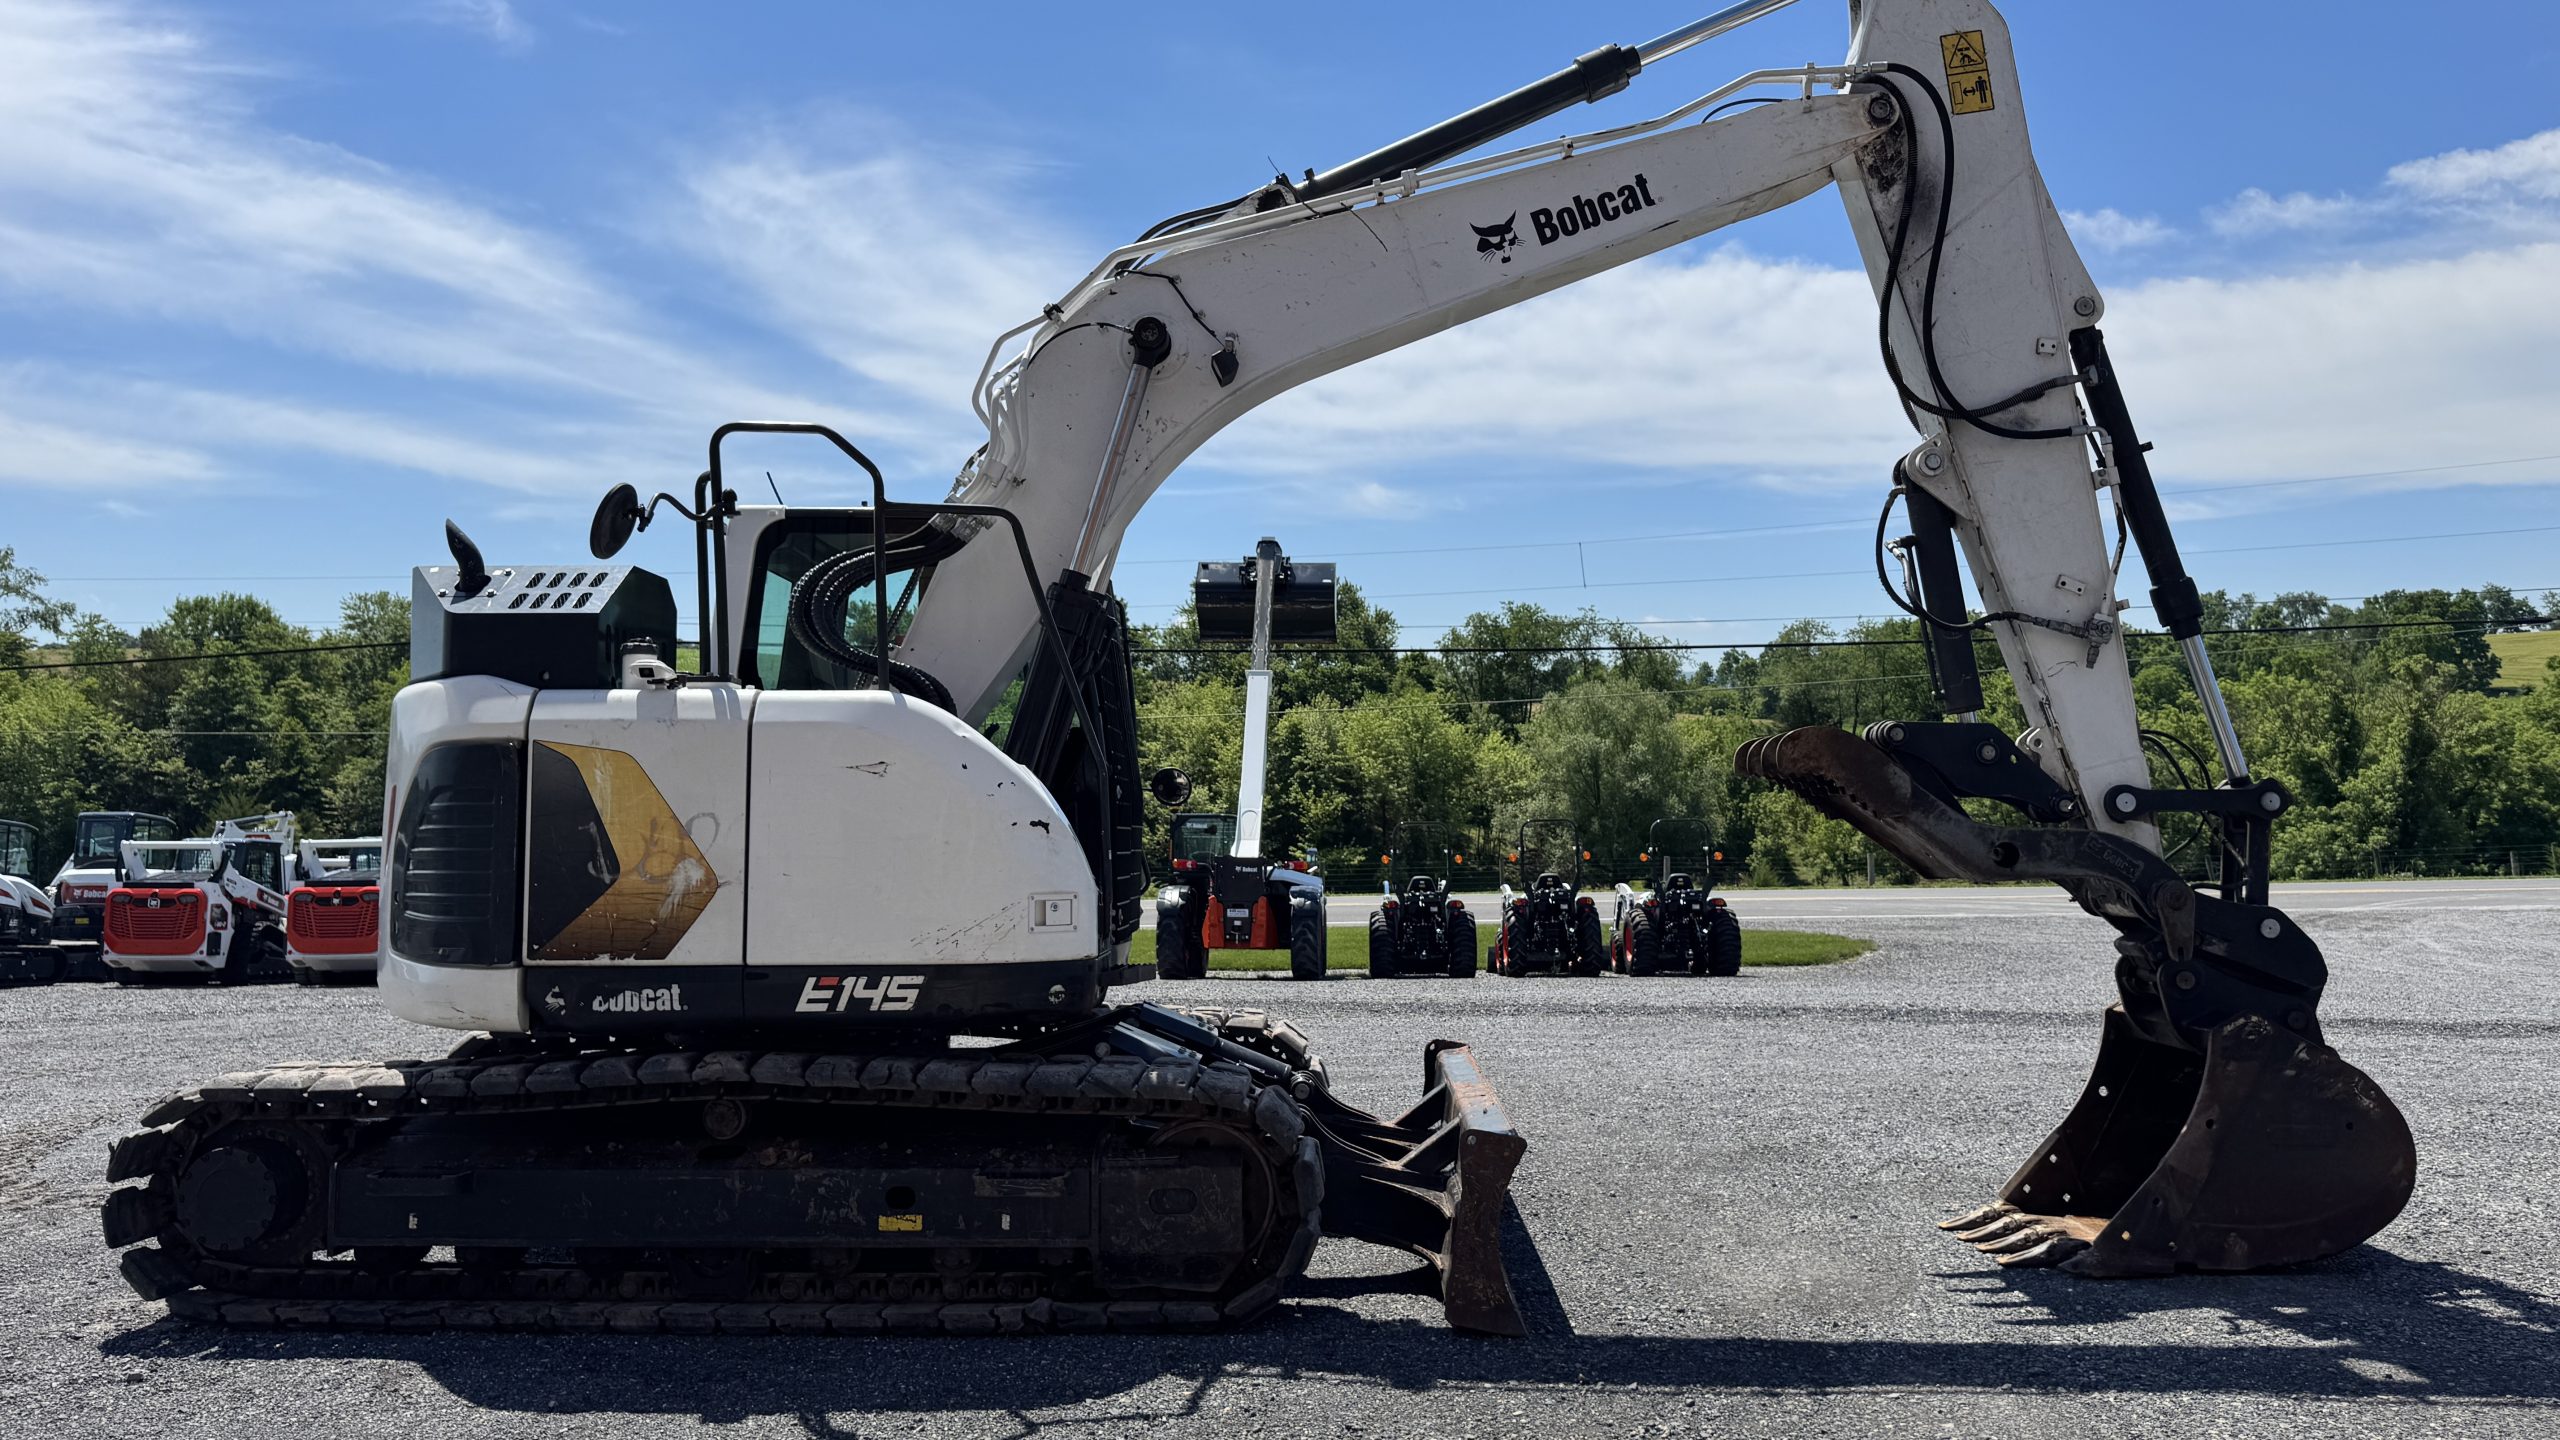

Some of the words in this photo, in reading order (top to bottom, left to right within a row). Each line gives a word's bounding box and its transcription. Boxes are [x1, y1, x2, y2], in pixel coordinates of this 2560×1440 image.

[1530, 173, 1656, 245] Bobcat
[83, 889, 106, 898] Bobca
[795, 975, 926, 1012] E145
